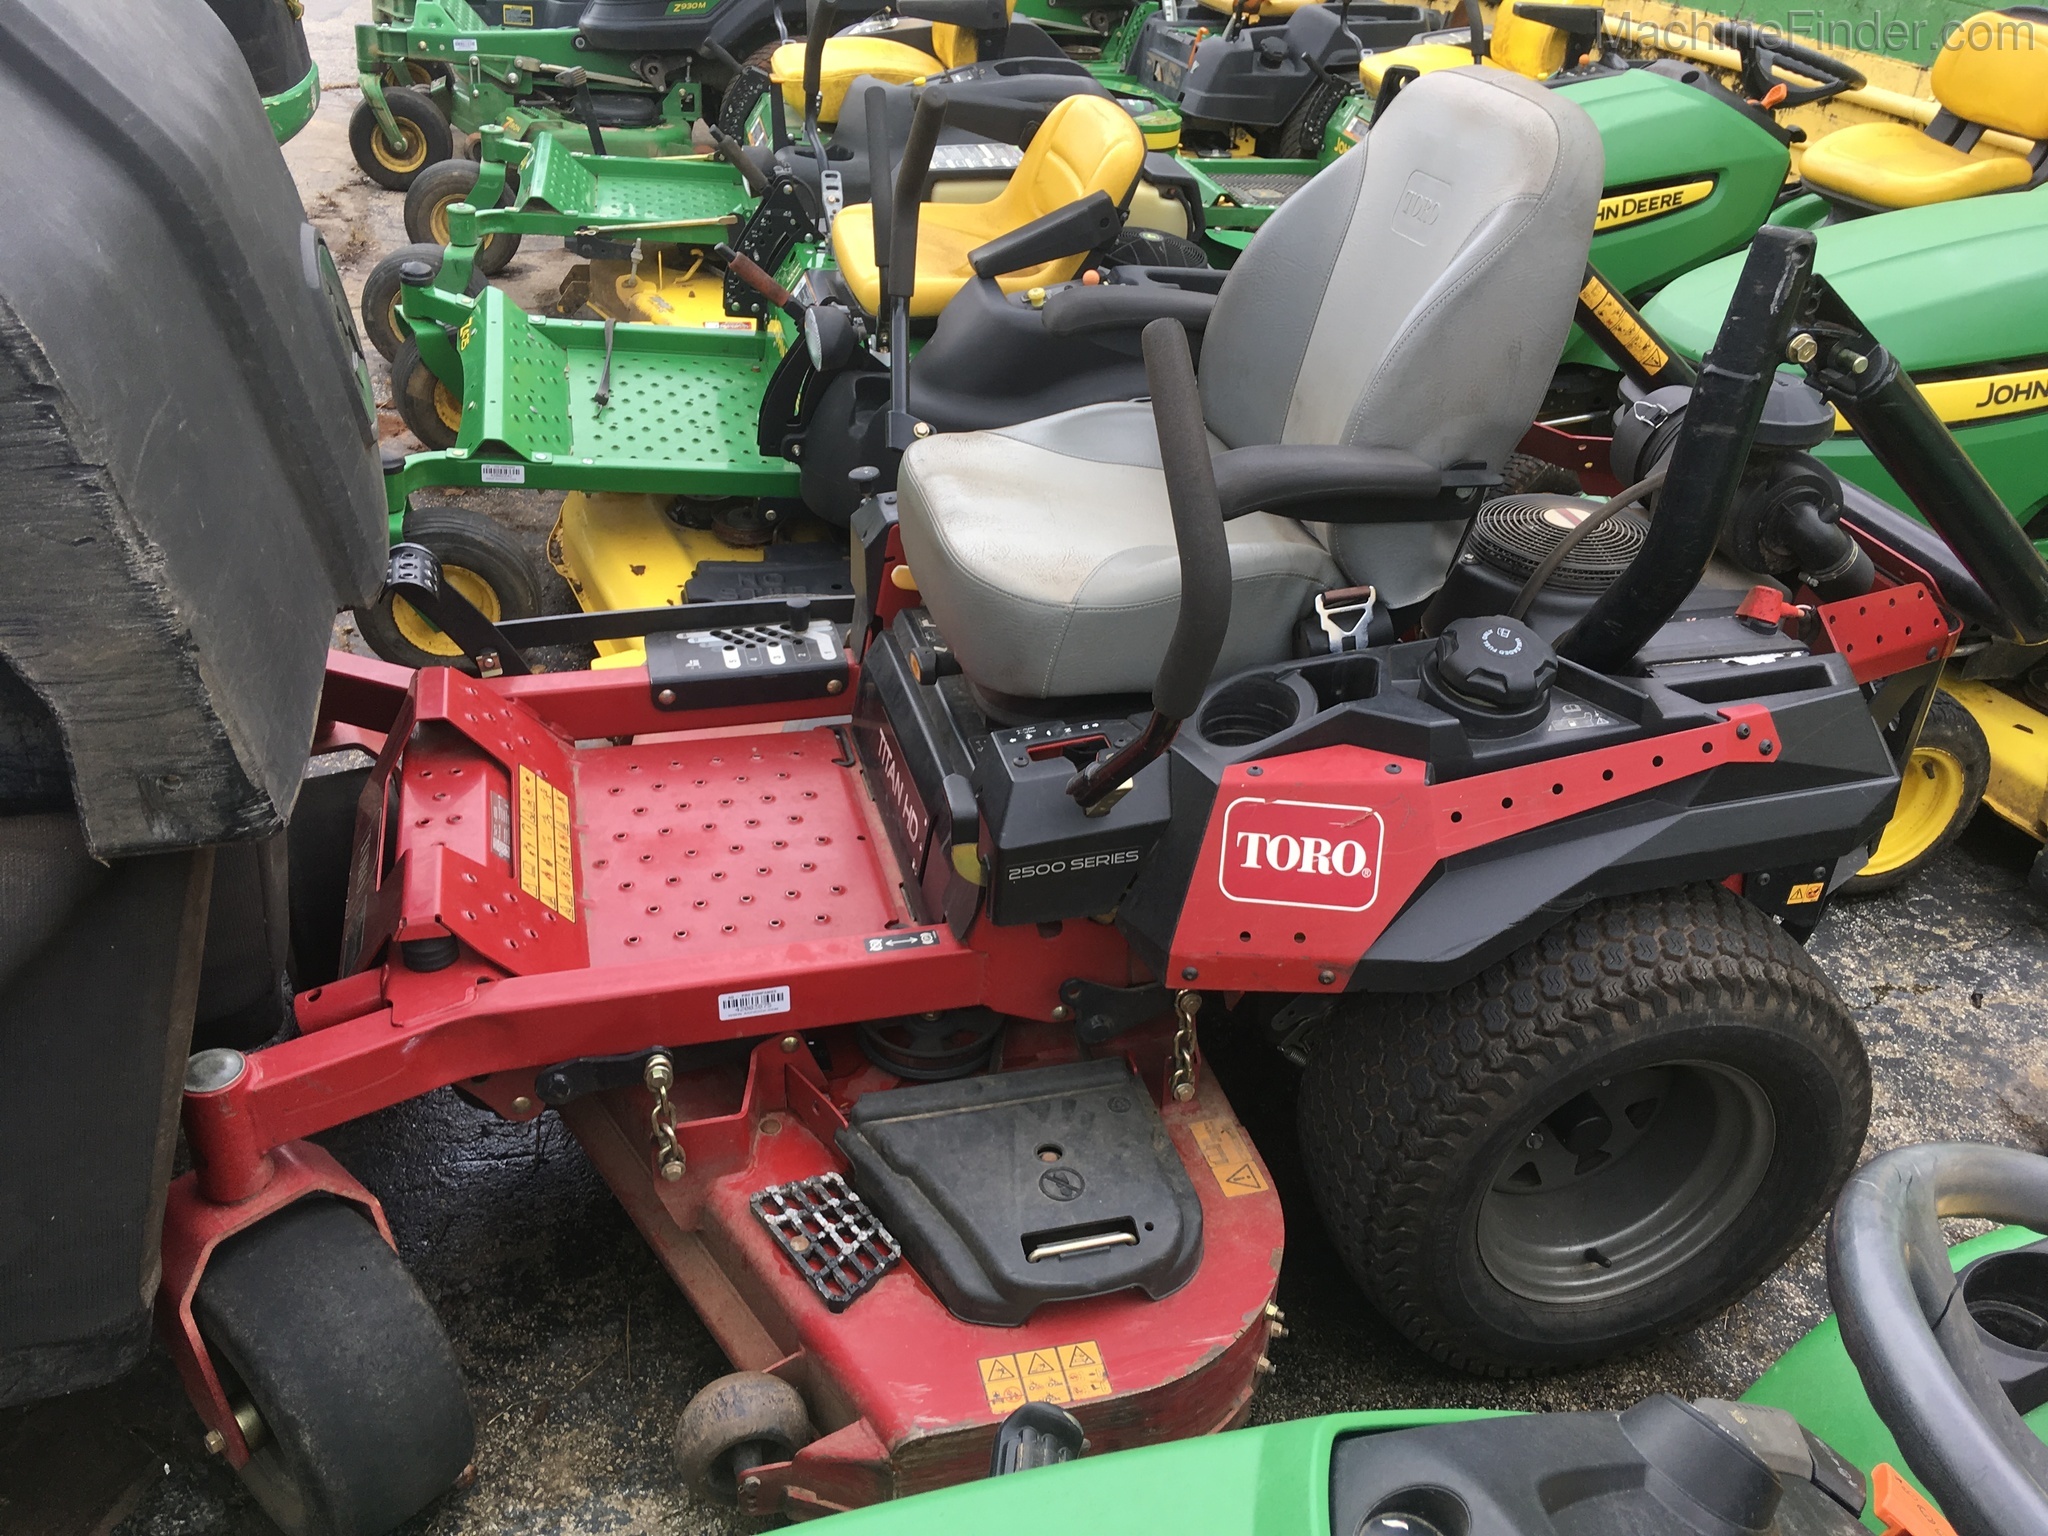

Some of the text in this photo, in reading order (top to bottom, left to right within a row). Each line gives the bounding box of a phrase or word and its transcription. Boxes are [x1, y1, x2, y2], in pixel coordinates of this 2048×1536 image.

[673, 2, 706, 12] Z930M
[1402, 189, 1441, 226] TORO
[1622, 191, 1684, 217] DEERE
[1976, 380, 2048, 408] JOHN
[878, 727, 919, 843] TITAN HD
[1008, 850, 1139, 881] 2500 SERIES
